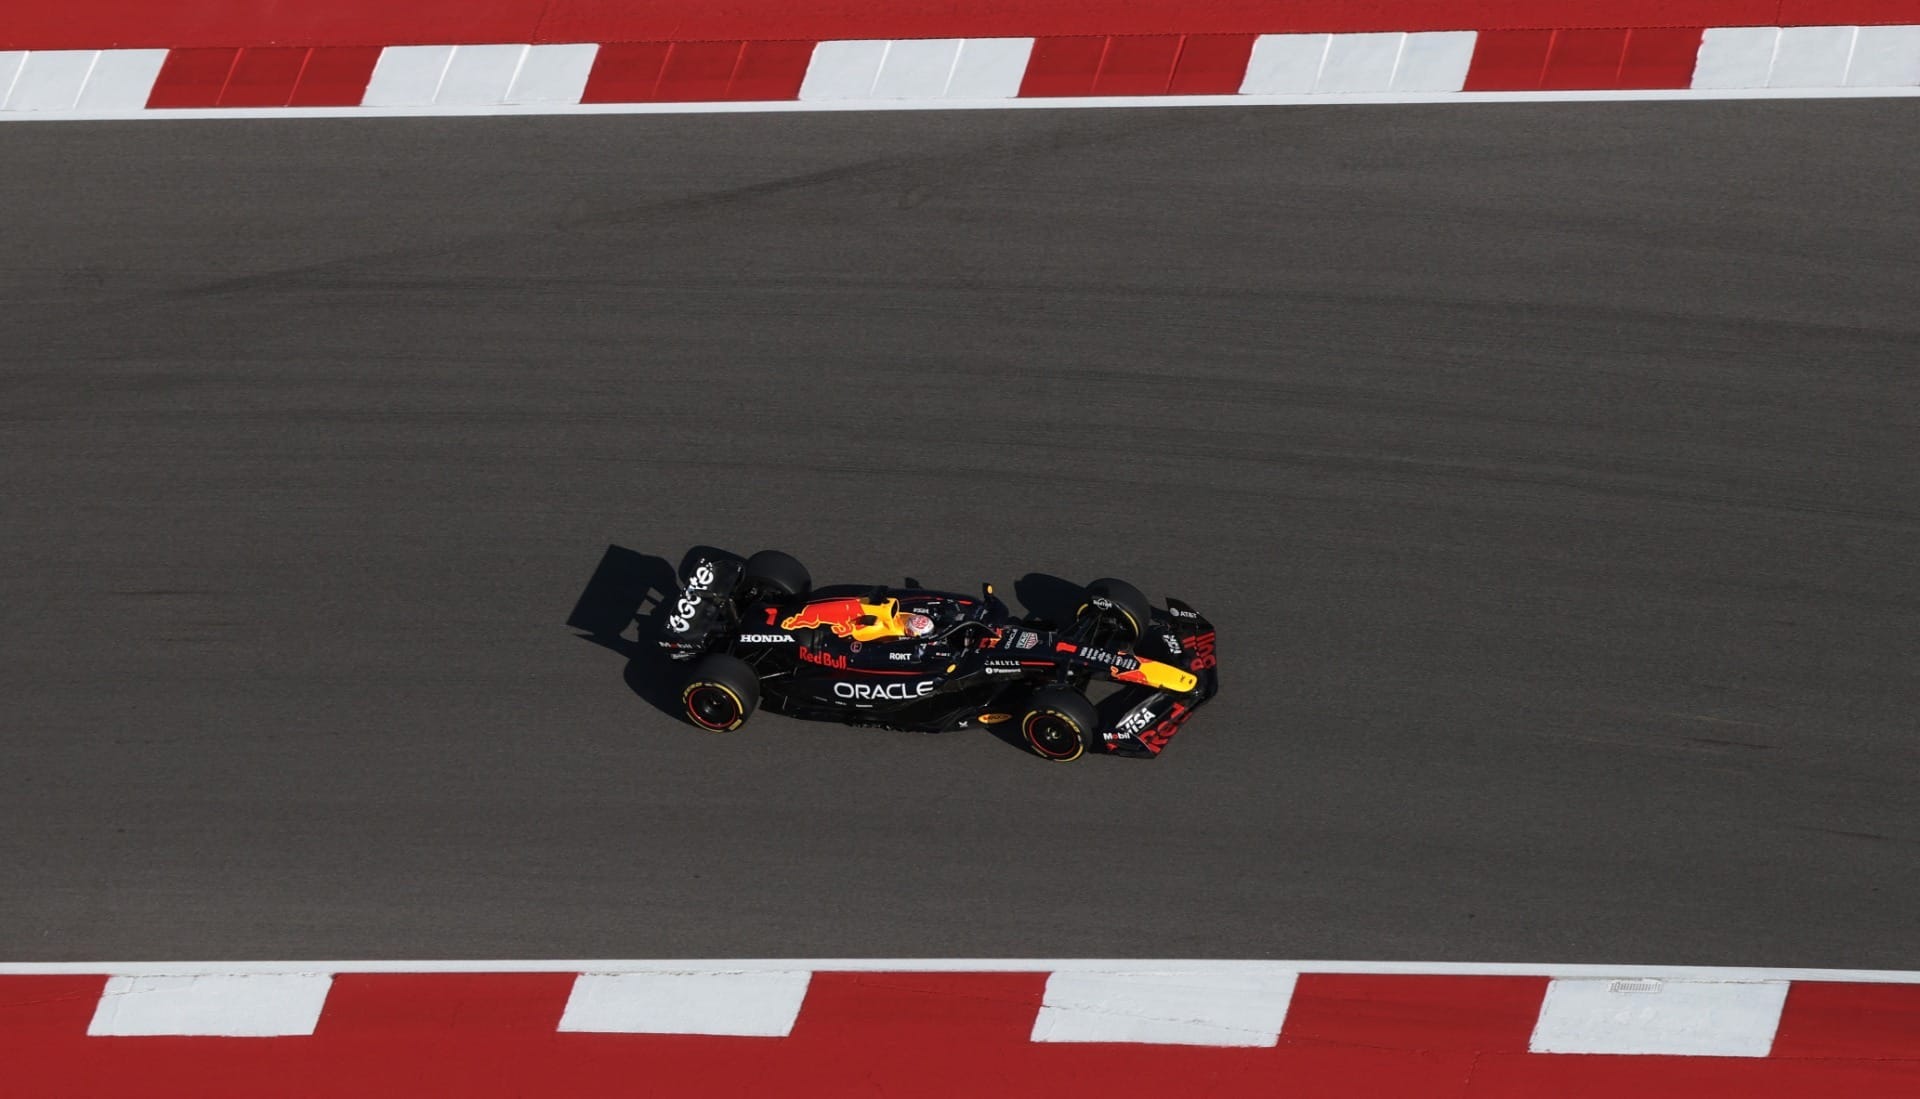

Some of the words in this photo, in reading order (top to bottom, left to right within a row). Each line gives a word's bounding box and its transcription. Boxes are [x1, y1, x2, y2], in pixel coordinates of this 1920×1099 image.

[765, 607, 778, 626] 1
[740, 634, 795, 643] HONDA
[800, 647, 821, 665] Red
[823, 652, 847, 670] Bull
[889, 652, 912, 661] ROKT
[833, 681, 934, 700] ORACLE
[1122, 707, 1156, 735] VISA
[1103, 732, 1130, 741] Mobil
